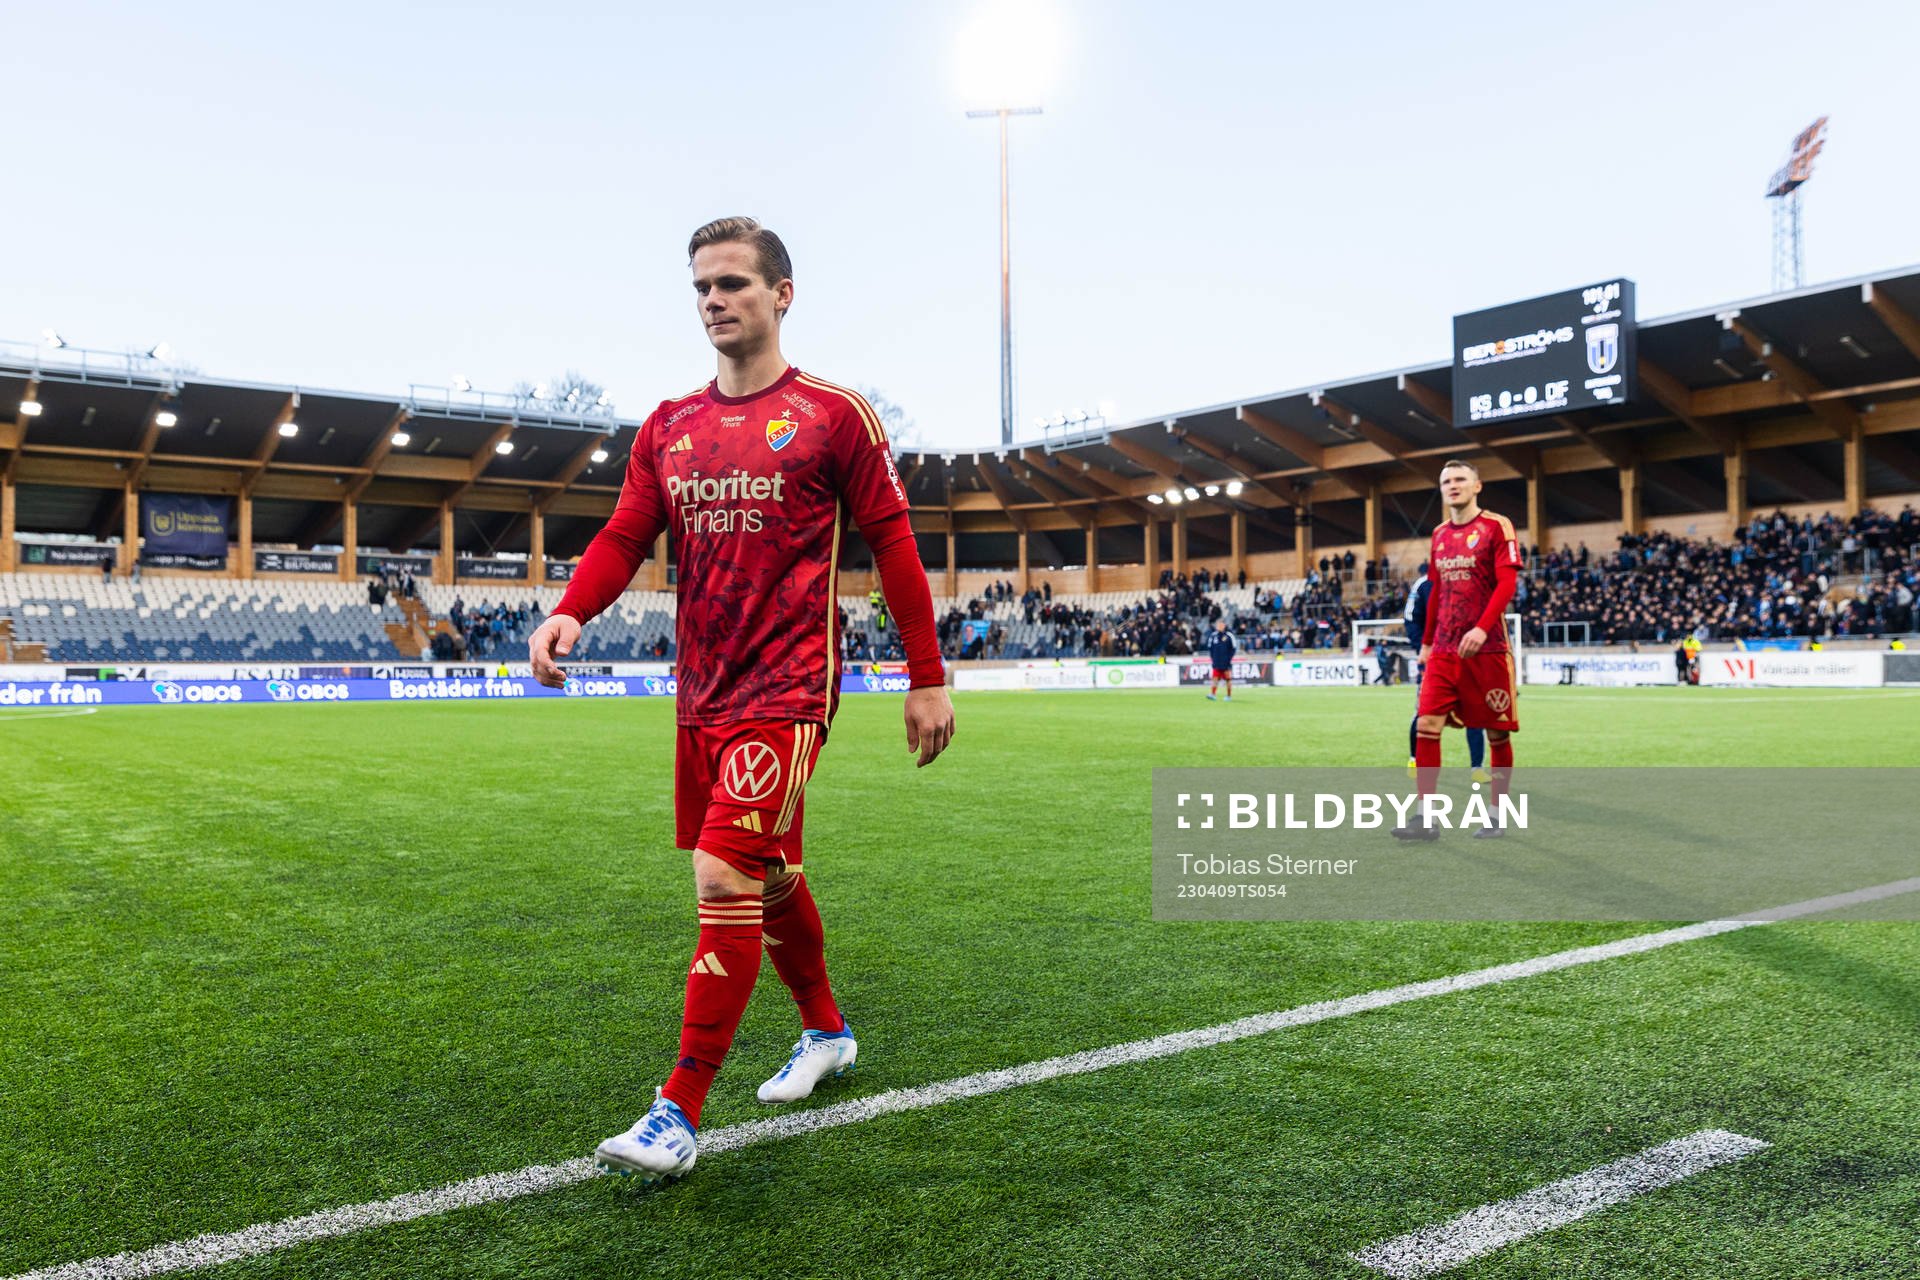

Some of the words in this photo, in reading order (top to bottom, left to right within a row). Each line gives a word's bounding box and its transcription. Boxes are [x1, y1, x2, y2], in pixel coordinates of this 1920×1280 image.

[667, 469, 786, 506] Prioritet
[680, 503, 763, 536] Finans
[48, 682, 102, 704] från
[185, 684, 243, 701] OBOS
[297, 683, 349, 700] OBOS
[389, 679, 482, 699] Bostäder
[484, 678, 525, 697] från
[584, 680, 627, 696] OBOS
[882, 678, 911, 691] OBO
